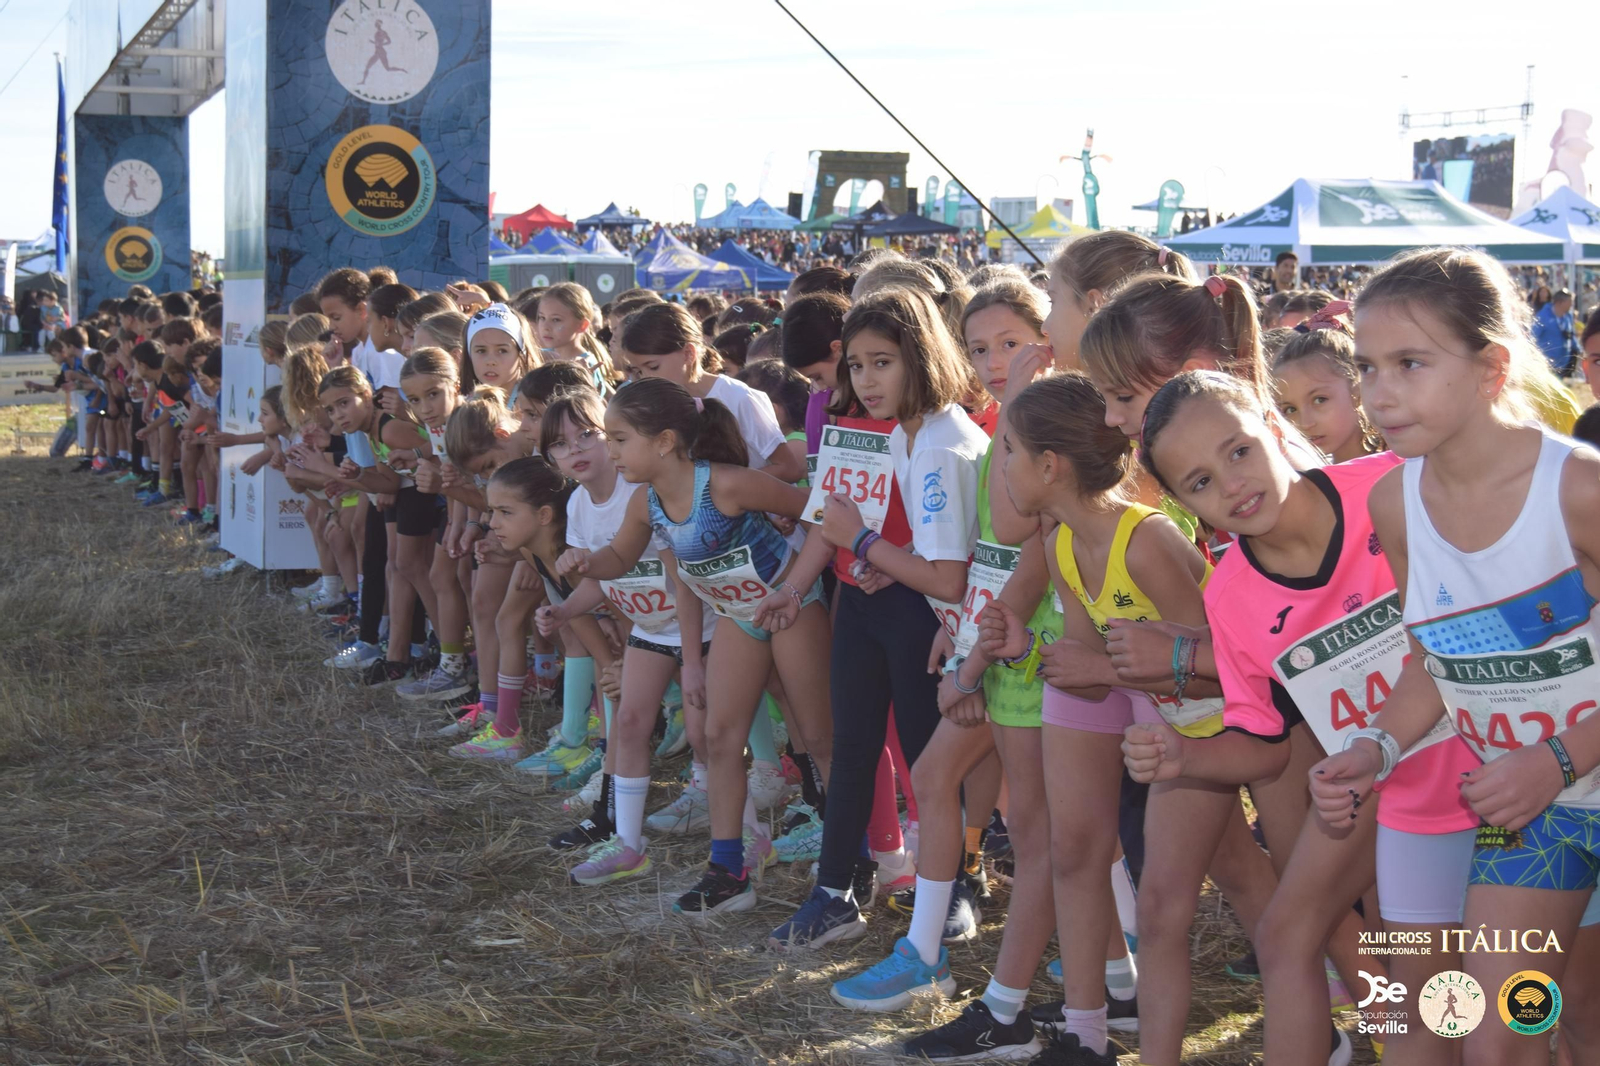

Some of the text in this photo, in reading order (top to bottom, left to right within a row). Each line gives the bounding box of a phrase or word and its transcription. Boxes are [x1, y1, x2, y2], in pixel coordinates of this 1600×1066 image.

[333, 131, 373, 169] GOLD LEVEL
[357, 199, 405, 209] ATHLETICS
[358, 159, 432, 231] WORLD CROSS COUNTRY TOUR
[364, 190, 398, 200] WORLD
[1222, 243, 1271, 261] Sevilla
[842, 432, 878, 449] ITÁLICA
[821, 466, 887, 507] 4534
[279, 521, 305, 529] KIROS
[689, 557, 728, 575] TÁLICA
[608, 585, 675, 615] 4502
[1320, 603, 1402, 654] ITÁLICA
[1329, 655, 1356, 672] GLORIA
[1356, 642, 1377, 659] ROSSI
[1350, 639, 1406, 671] TROTACOLONIA
[1453, 659, 1545, 680] ITÁLICA
[1560, 662, 1583, 674] Sevilla
[1455, 683, 1562, 696] ESTHER VALLEJO NAVARRO
[1330, 669, 1393, 732] 44
[1488, 696, 1527, 704] TOMARES
